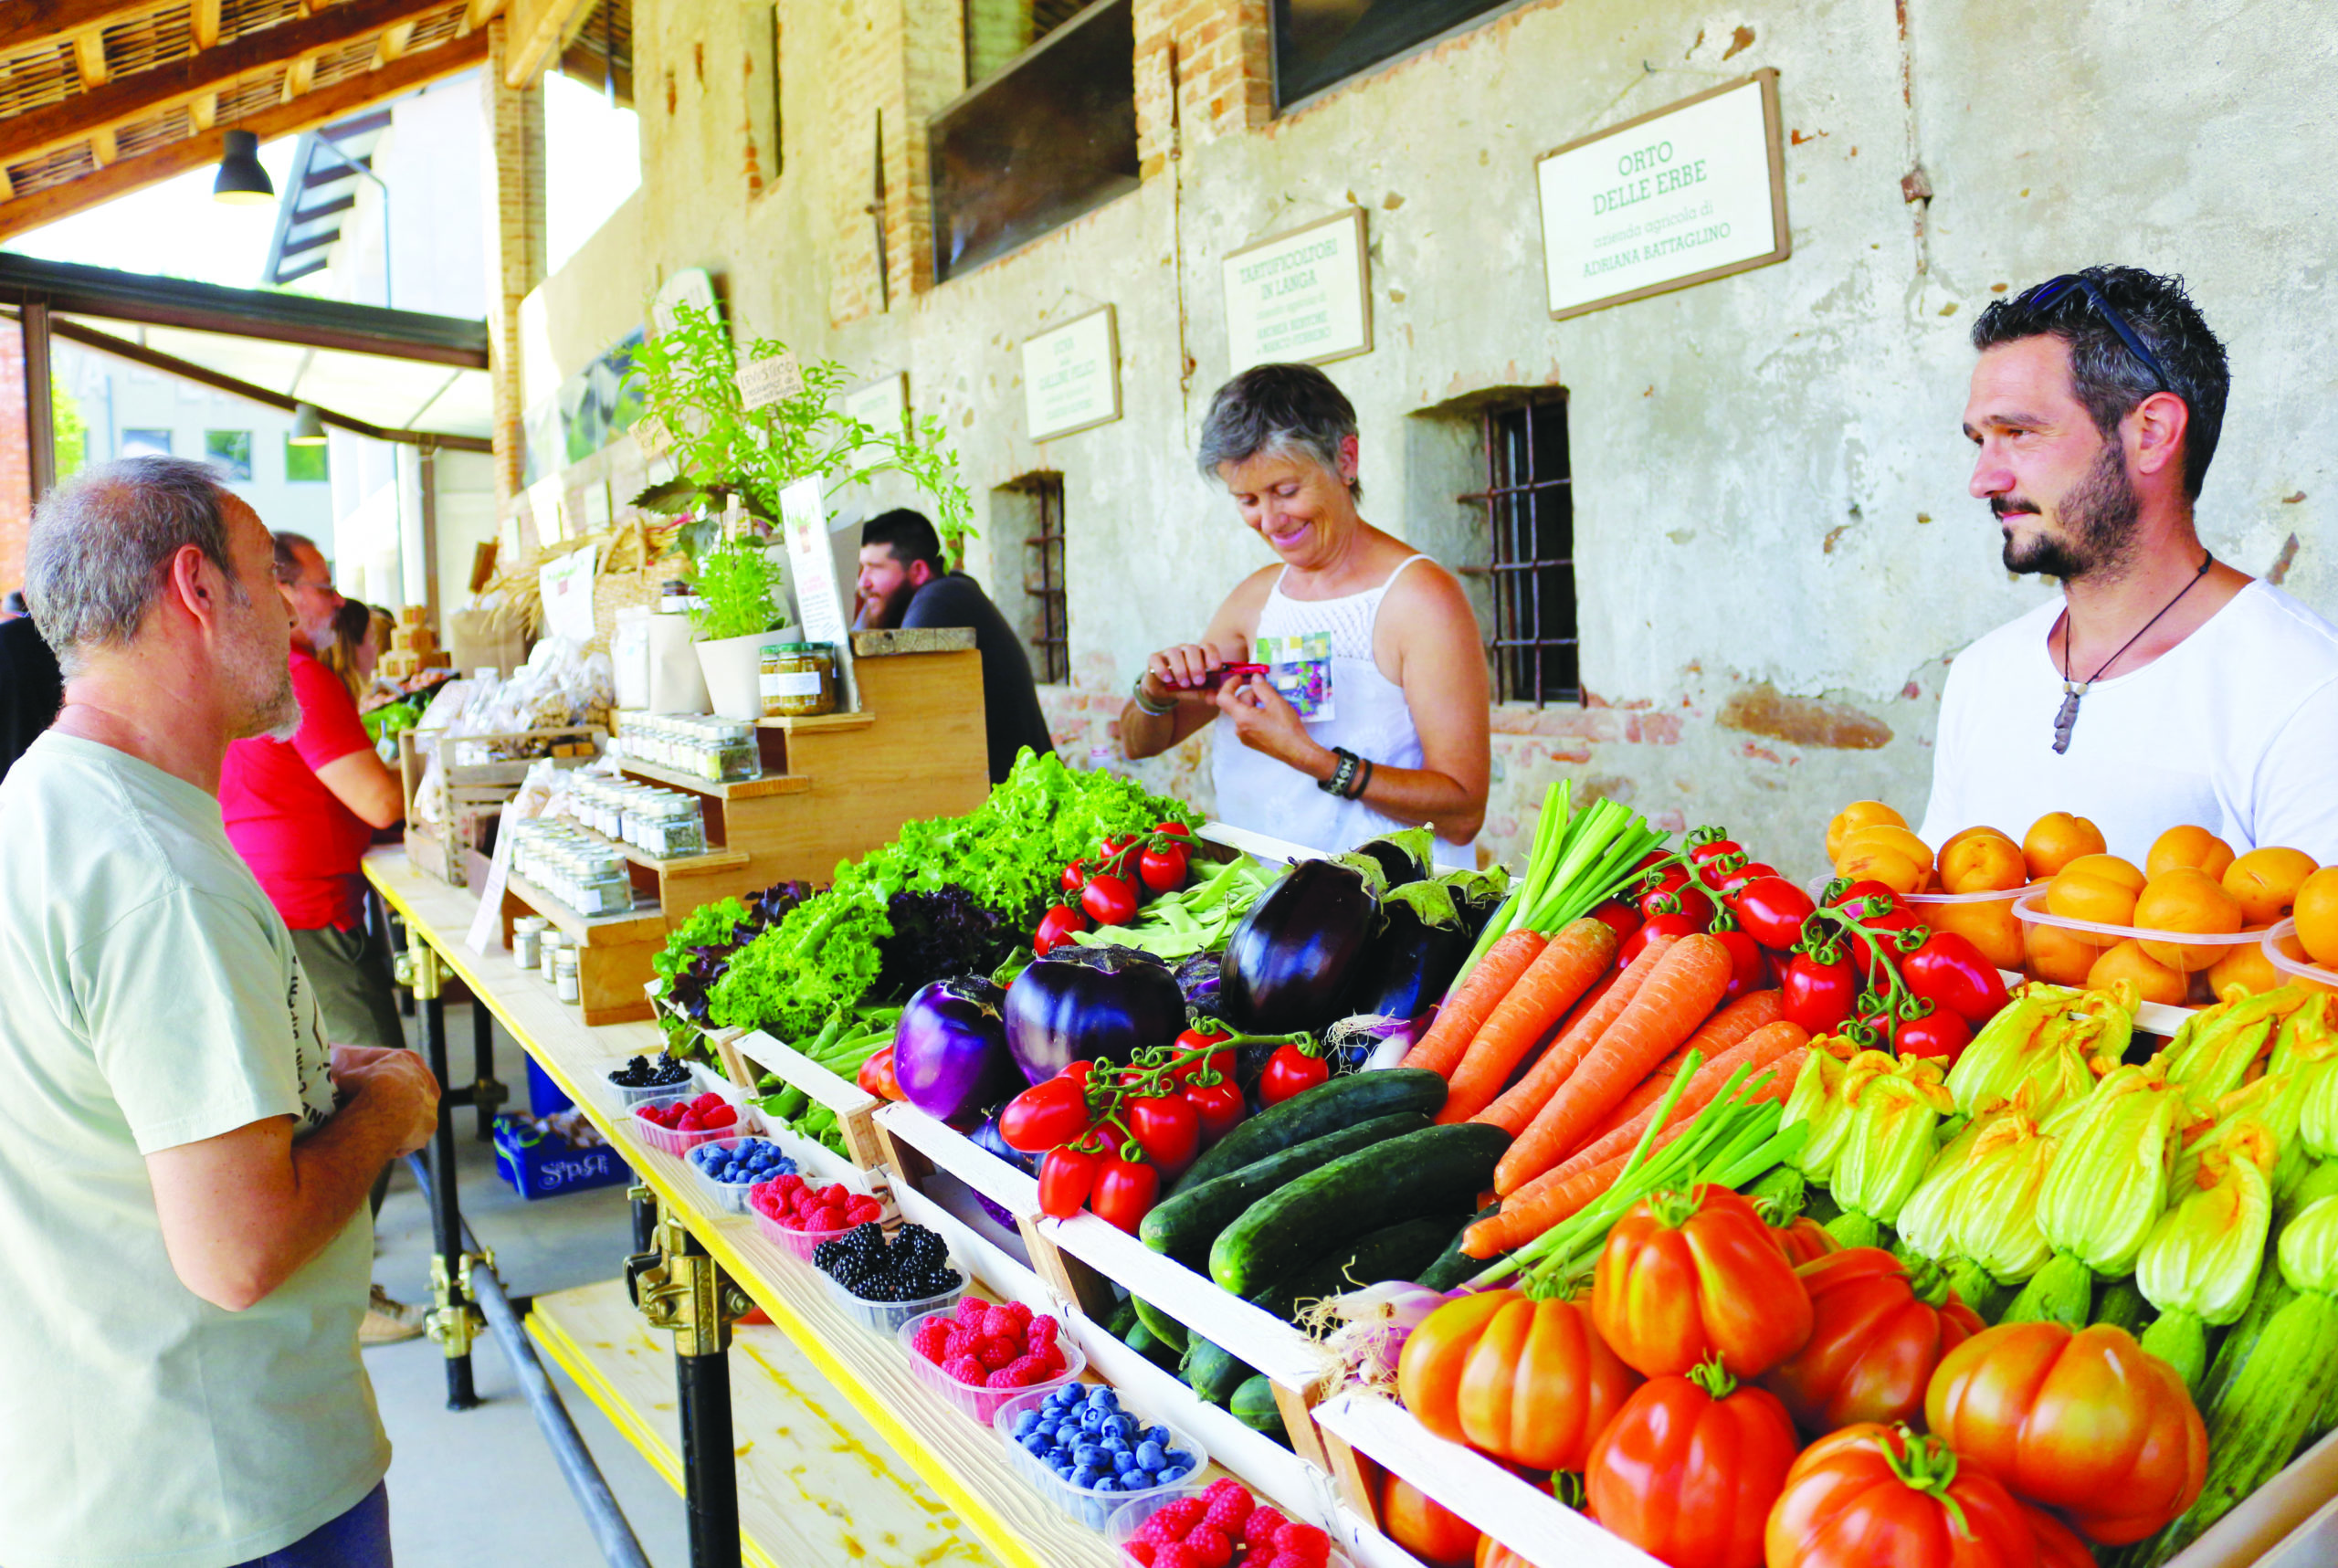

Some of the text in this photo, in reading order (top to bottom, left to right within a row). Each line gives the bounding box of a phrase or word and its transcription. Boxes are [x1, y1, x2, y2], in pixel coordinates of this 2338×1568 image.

[1617, 141, 1673, 176] ORTO
[1592, 159, 1708, 216] DELLE ERBE
[1593, 199, 1714, 248] azienda agricola di
[1583, 222, 1732, 278] ADRIANA BATTAGLINO
